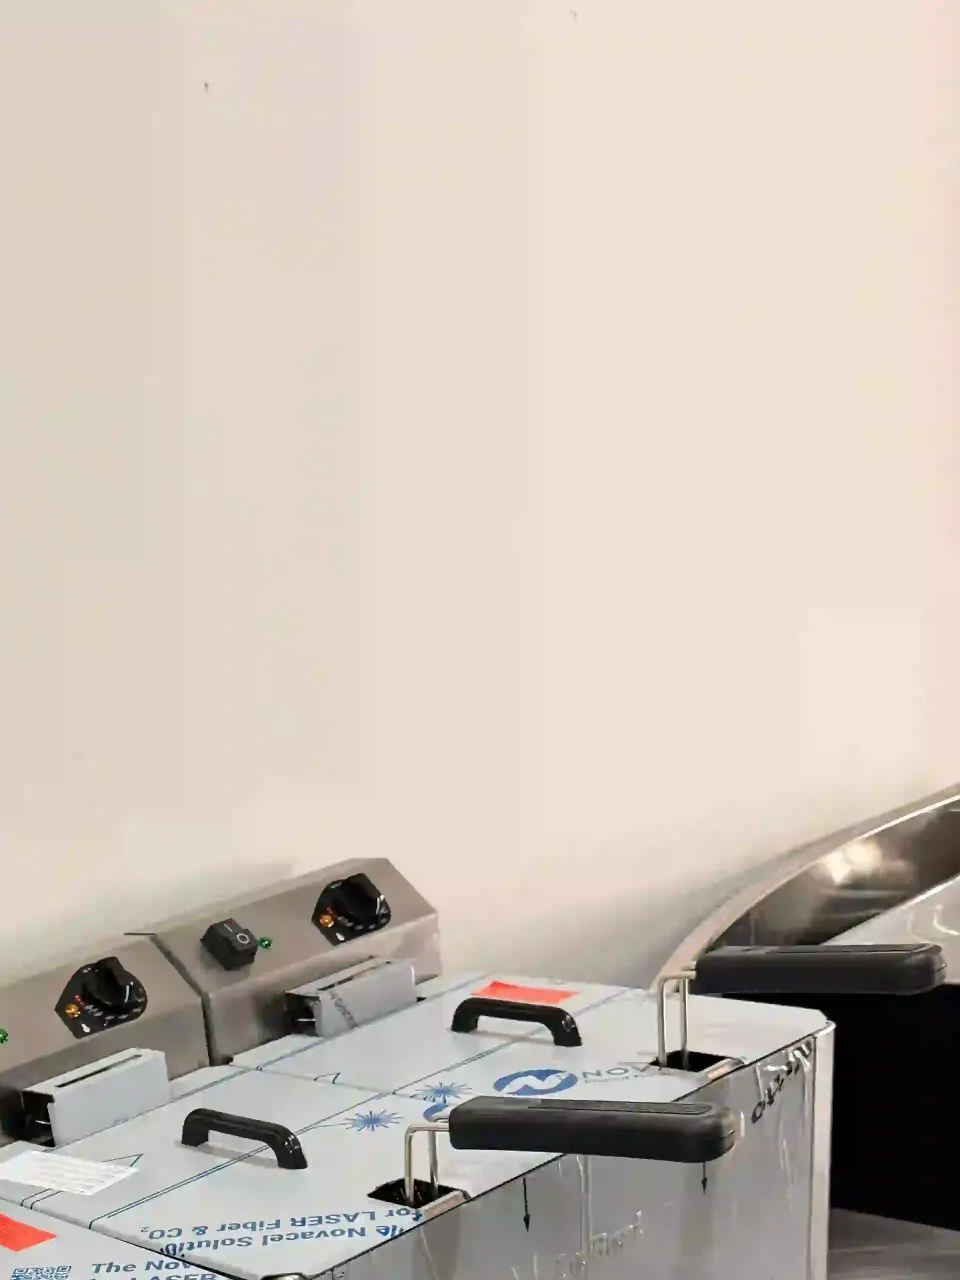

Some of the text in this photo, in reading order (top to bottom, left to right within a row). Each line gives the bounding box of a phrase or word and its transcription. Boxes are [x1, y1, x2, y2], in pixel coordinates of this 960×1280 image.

[290, 1210, 377, 1227] LASER
[384, 1208, 422, 1222] for
[191, 1225, 209, 1236] &
[219, 1219, 281, 1232] Fiber
[262, 1226, 367, 1247] Novacel
[159, 1235, 254, 1258] Solutio
[91, 1261, 137, 1274] The
